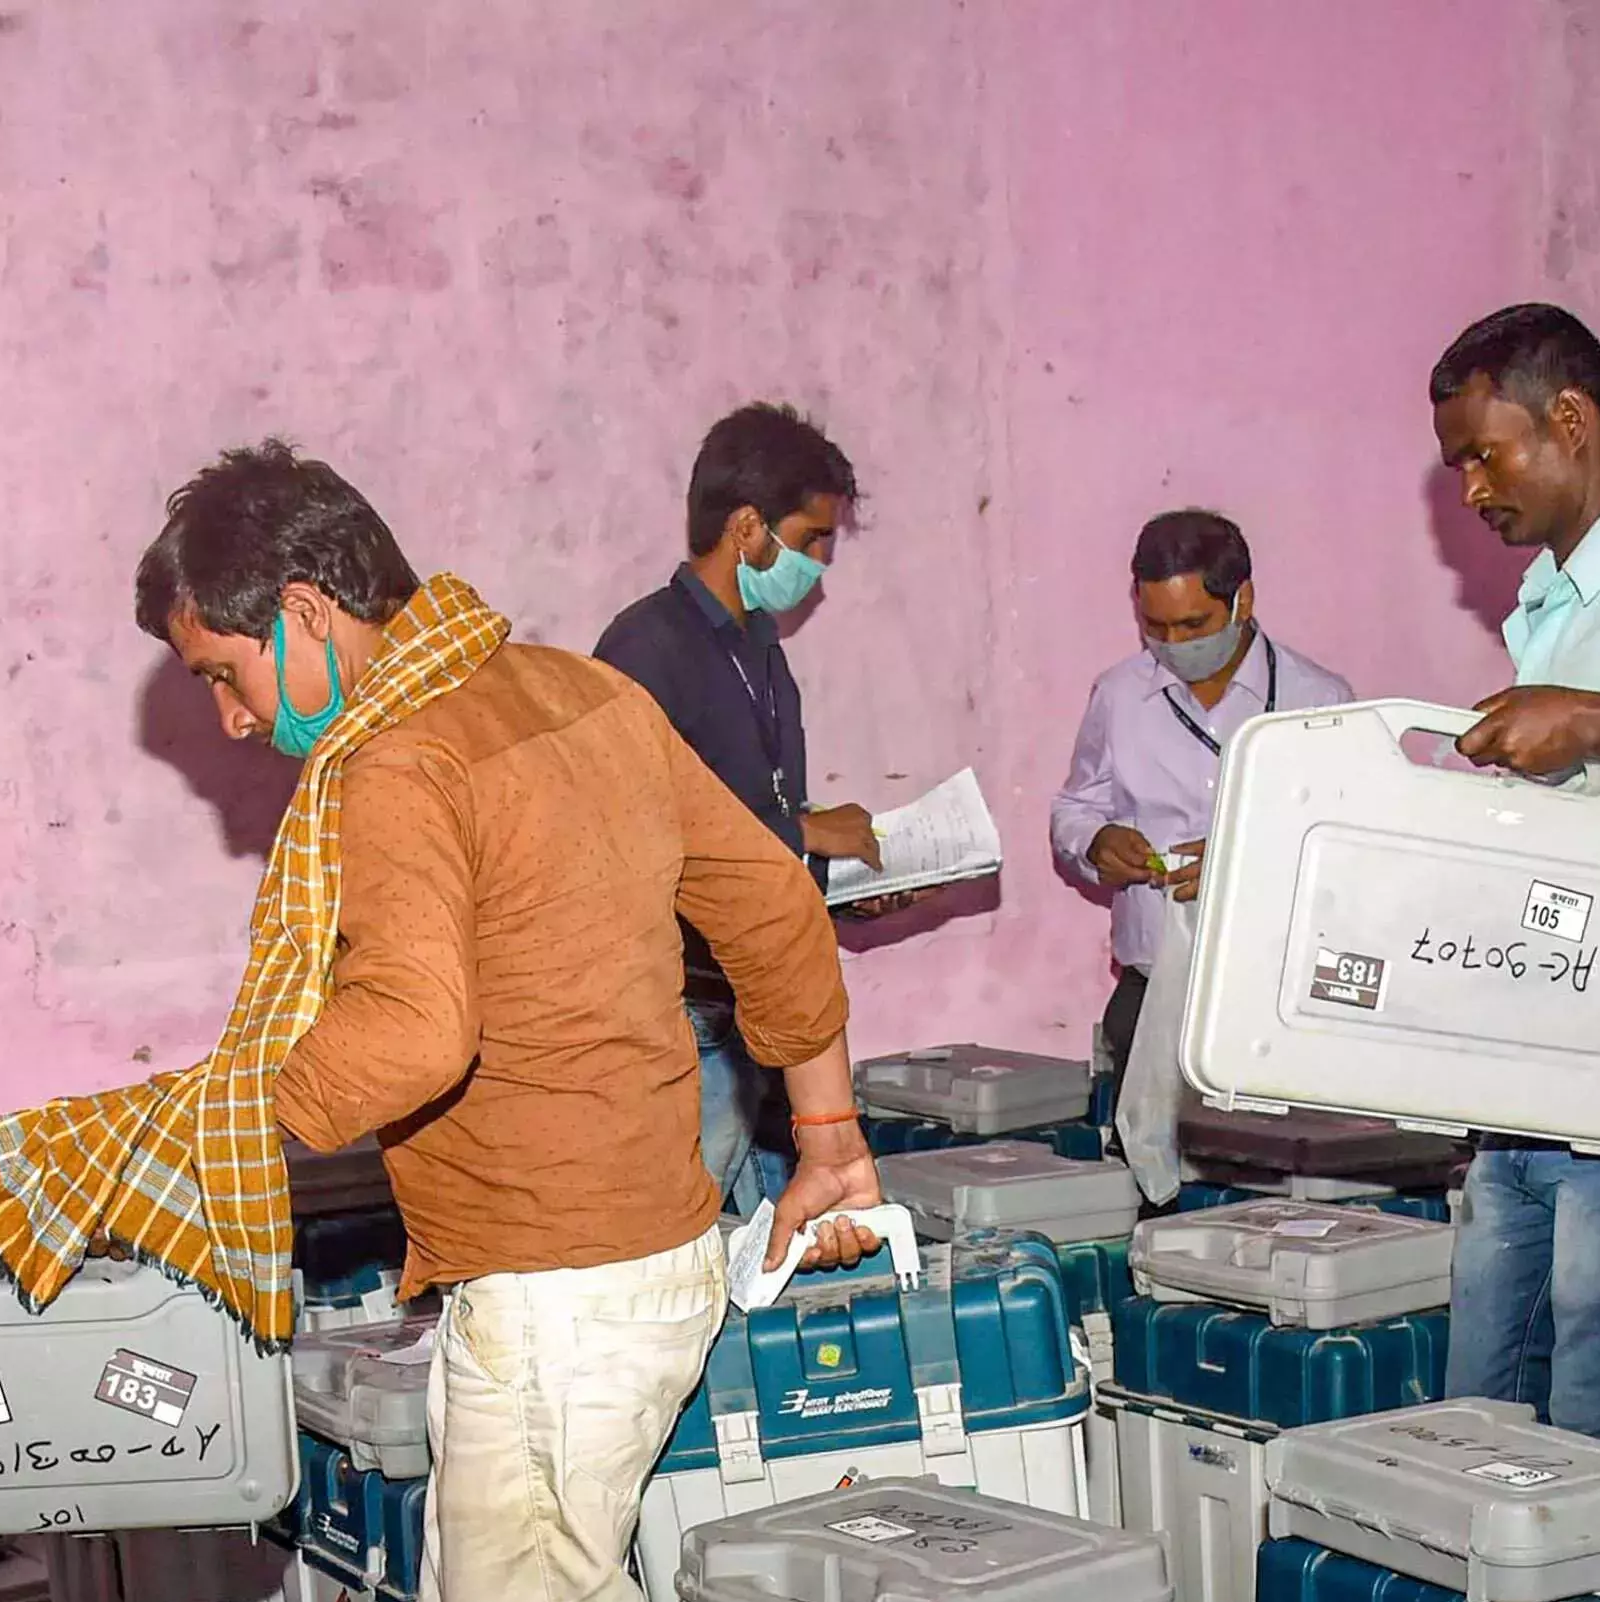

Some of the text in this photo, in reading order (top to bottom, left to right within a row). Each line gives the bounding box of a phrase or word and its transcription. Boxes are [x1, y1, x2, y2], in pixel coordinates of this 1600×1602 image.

[1528, 904, 1560, 931] 105
[1338, 954, 1379, 986] 183
[104, 1373, 158, 1412] 183
